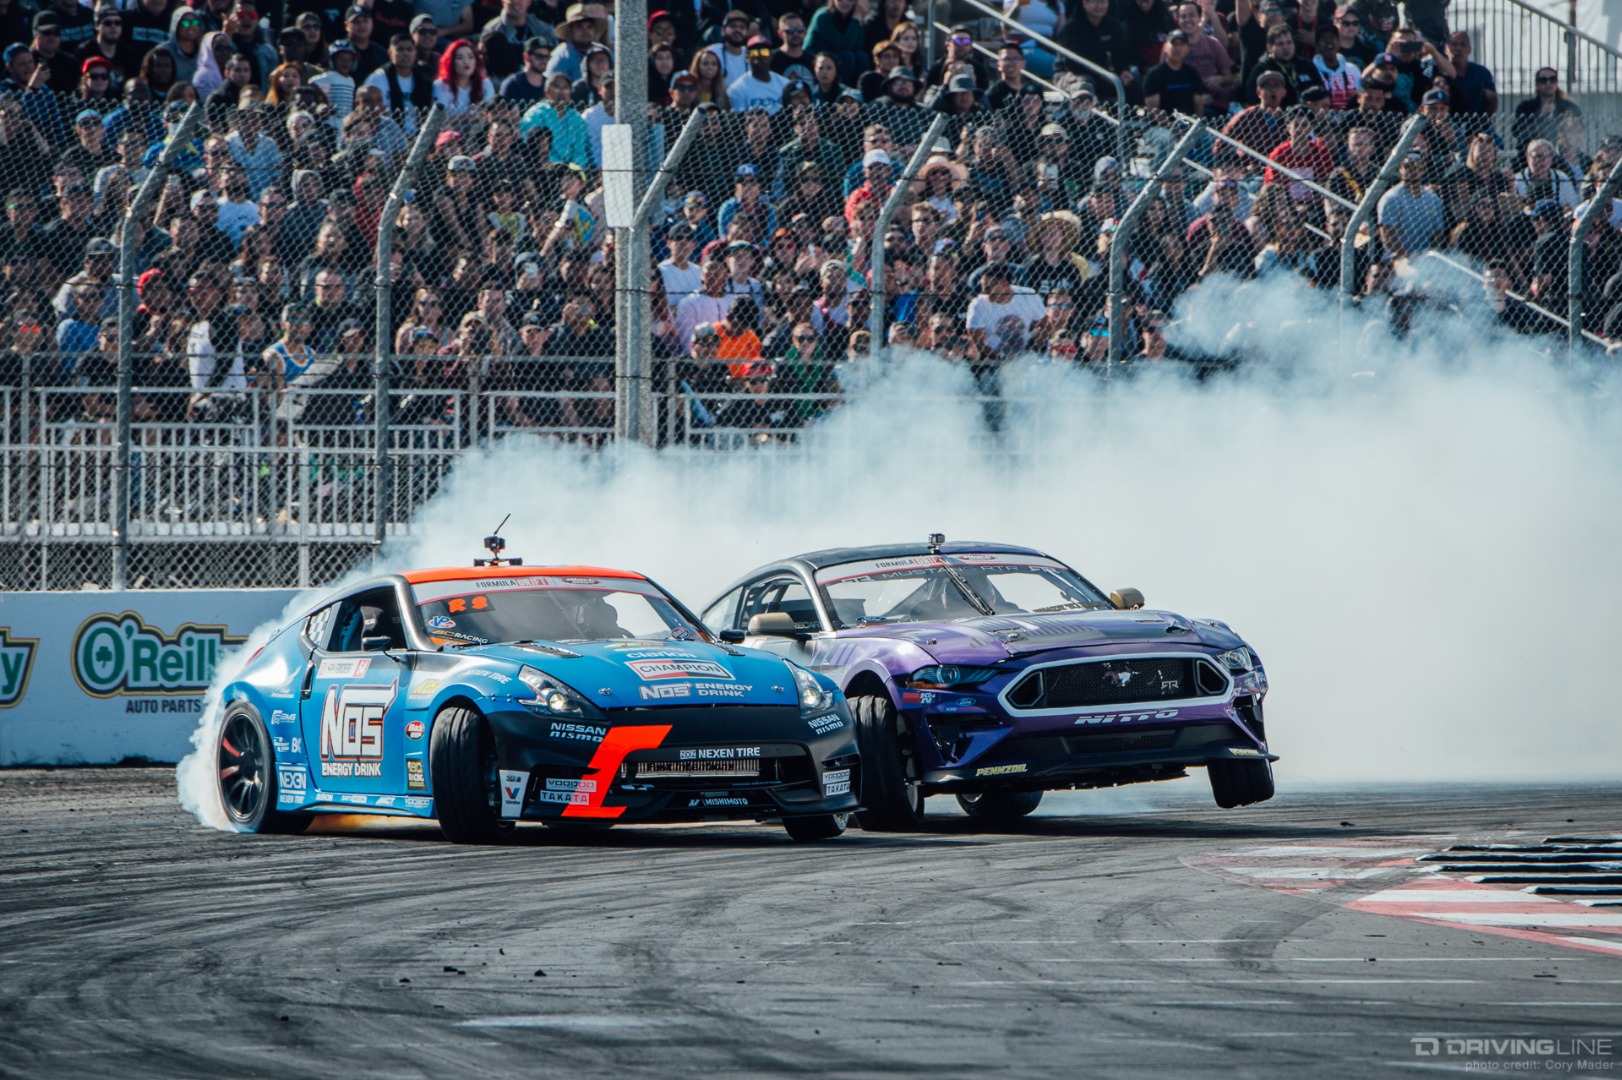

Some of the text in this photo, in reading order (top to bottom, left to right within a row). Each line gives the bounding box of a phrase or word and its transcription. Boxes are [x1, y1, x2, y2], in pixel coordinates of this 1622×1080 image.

[876, 559, 914, 568] FORMULA
[475, 580, 516, 589] FORMULA
[794, 621, 821, 629] RECAR
[454, 632, 488, 645] RACING
[83, 625, 217, 685] O'Reill
[626, 651, 697, 659] Clarion
[639, 663, 722, 675] CHAMPION
[640, 682, 753, 700] NOS ENERGY
[699, 690, 745, 698] DRINK
[126, 699, 201, 713] AUTO PARTS
[320, 681, 398, 761] NOS
[808, 714, 840, 729] NISSAN
[1074, 709, 1179, 725] NITTO
[550, 723, 606, 735] NISSAN
[815, 721, 844, 735] nismo
[549, 731, 604, 742] nismo
[698, 749, 734, 759] NEXEN
[736, 747, 760, 757] TIRE
[321, 762, 382, 777] ENERGY DRINK
[975, 764, 1028, 777] PENNZOIL
[548, 779, 595, 789] VOODOO
[828, 783, 850, 794] TAKATA
[541, 792, 588, 803] TAKATA
[705, 797, 749, 806] MISHIMOTO
